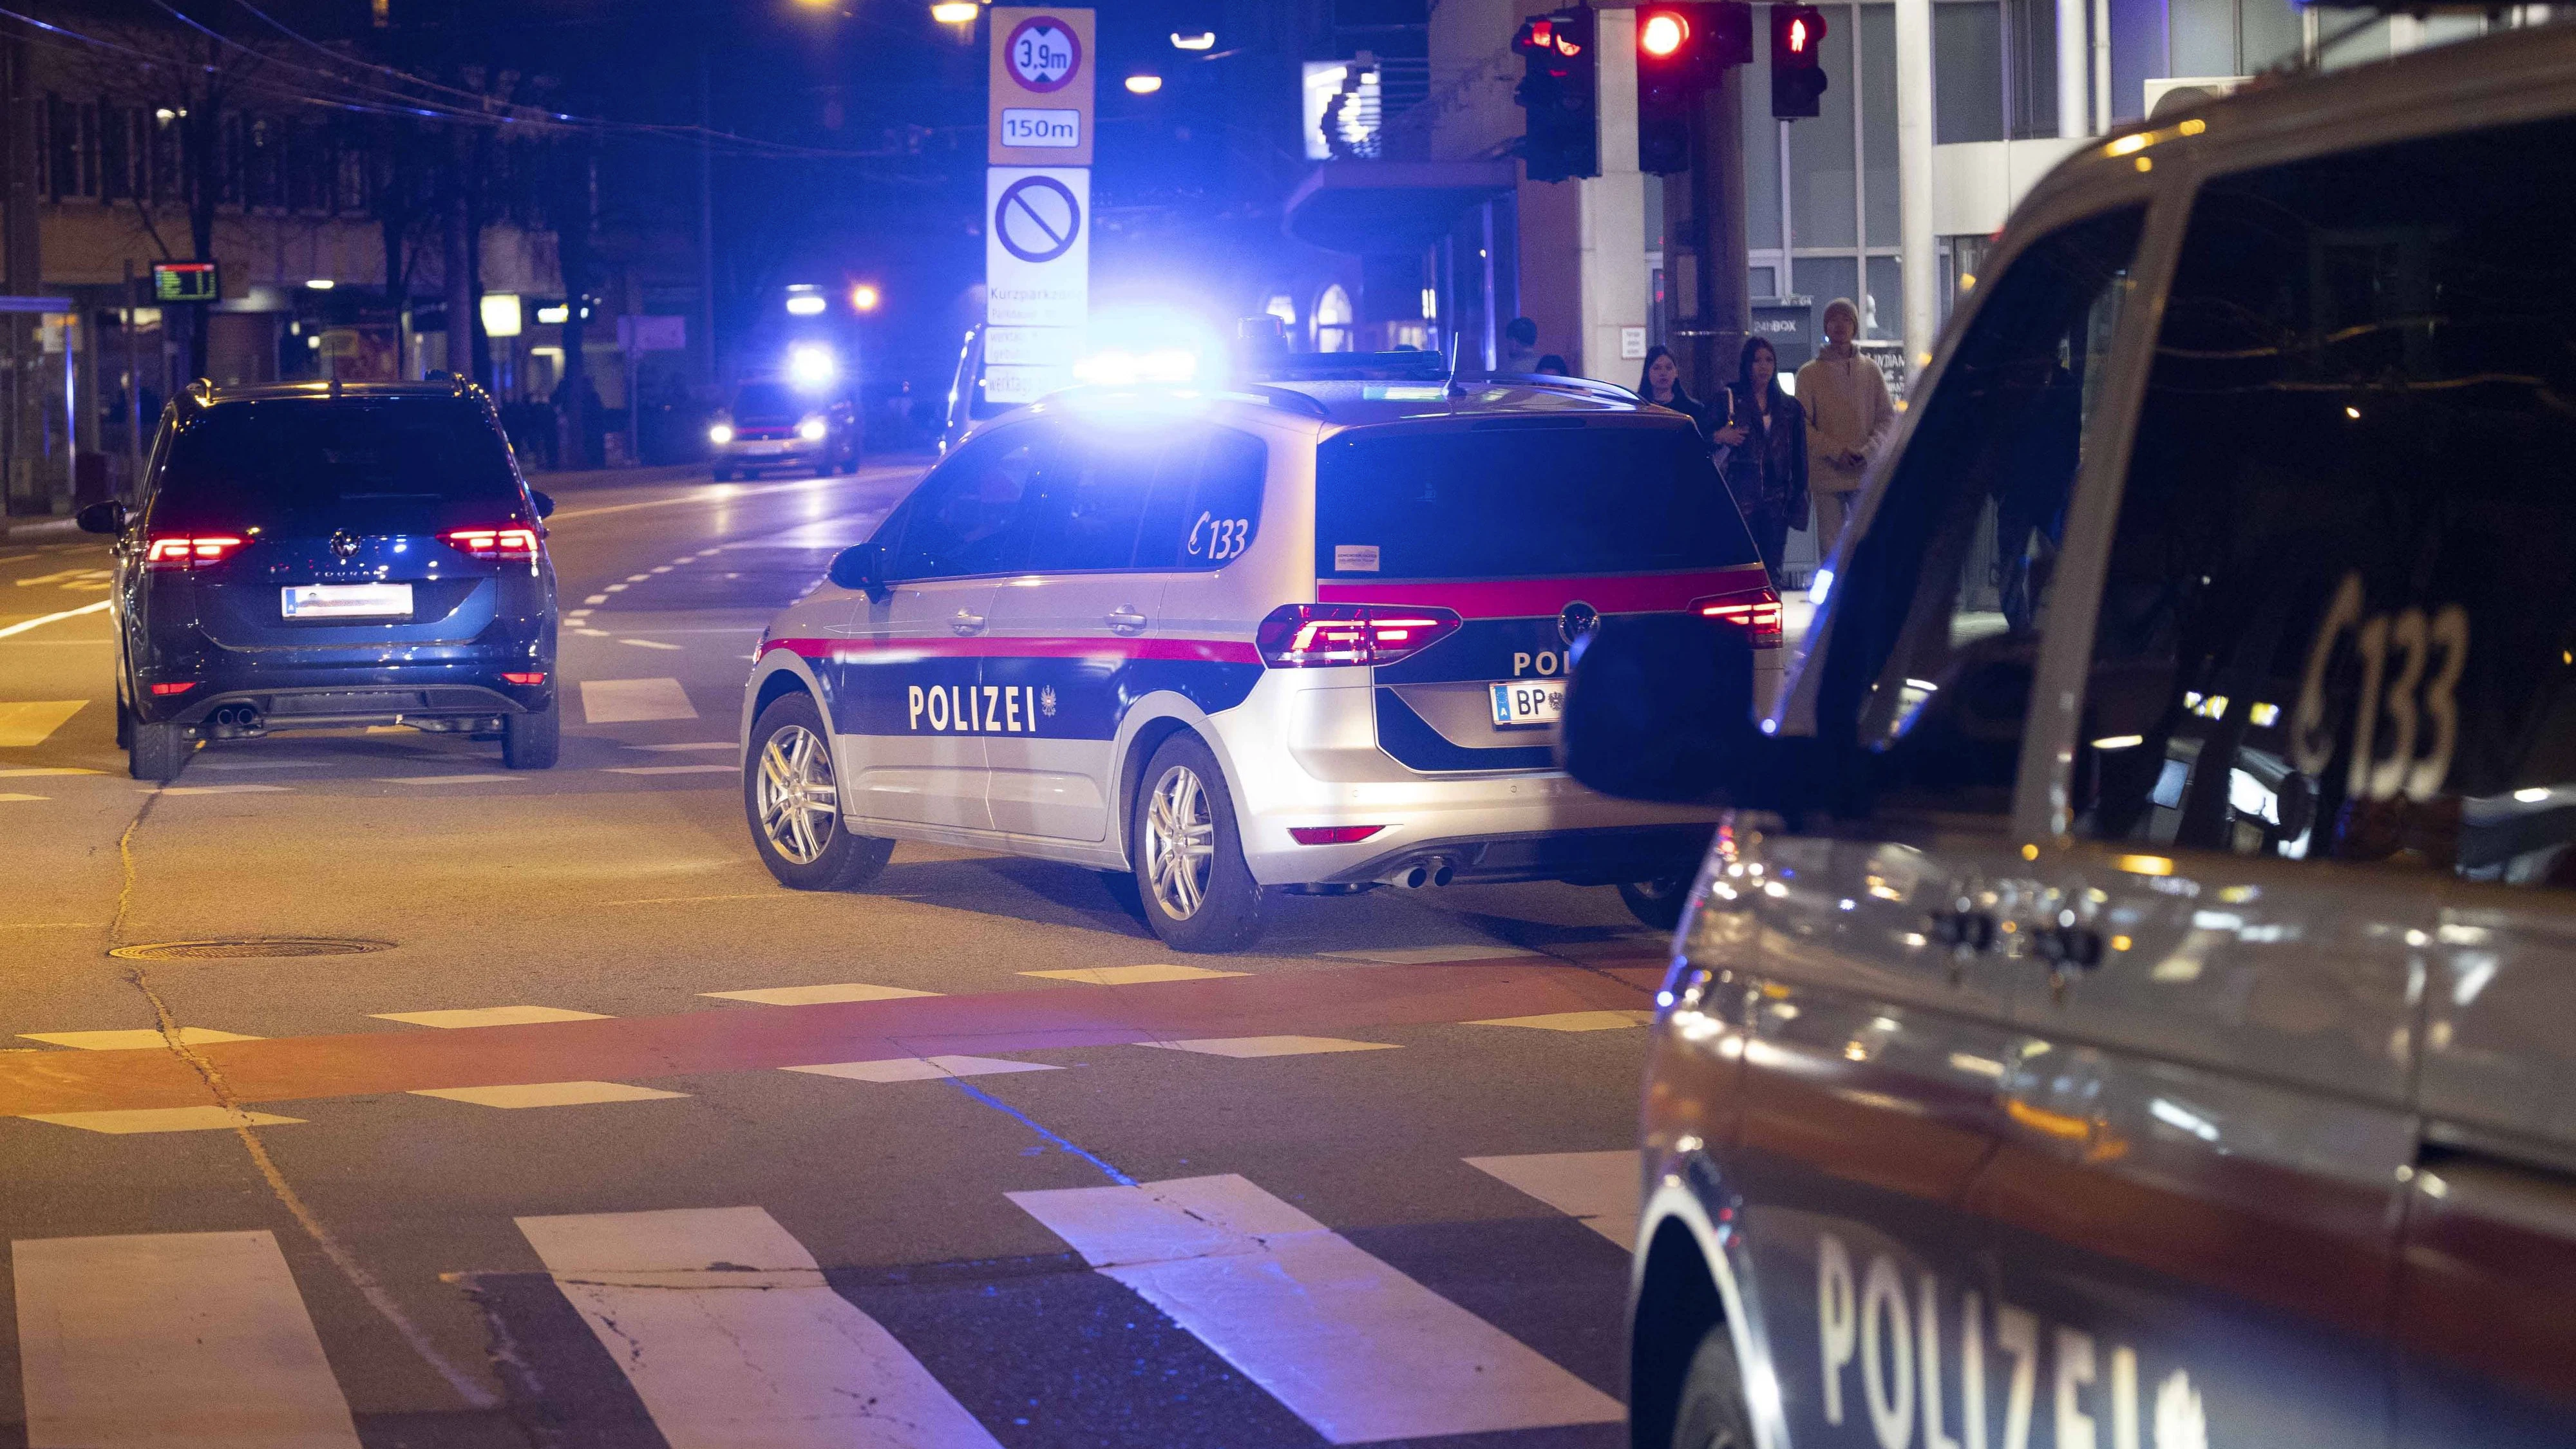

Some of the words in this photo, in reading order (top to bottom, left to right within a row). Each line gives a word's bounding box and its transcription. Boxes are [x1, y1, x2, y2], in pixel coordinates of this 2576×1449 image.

[1020, 39, 1067, 70] 3,9m
[1007, 119, 1073, 138] 150m
[990, 287, 1083, 302] Kurzparkzo
[1208, 518, 1249, 560] 133
[1513, 650, 1571, 676] POL
[909, 685, 1036, 732] POLIZEI
[1500, 707, 1508, 716] A
[1516, 688, 1546, 715] BP
[2347, 603, 2470, 802] 133
[1819, 1233, 2139, 1449] POLIZEI
